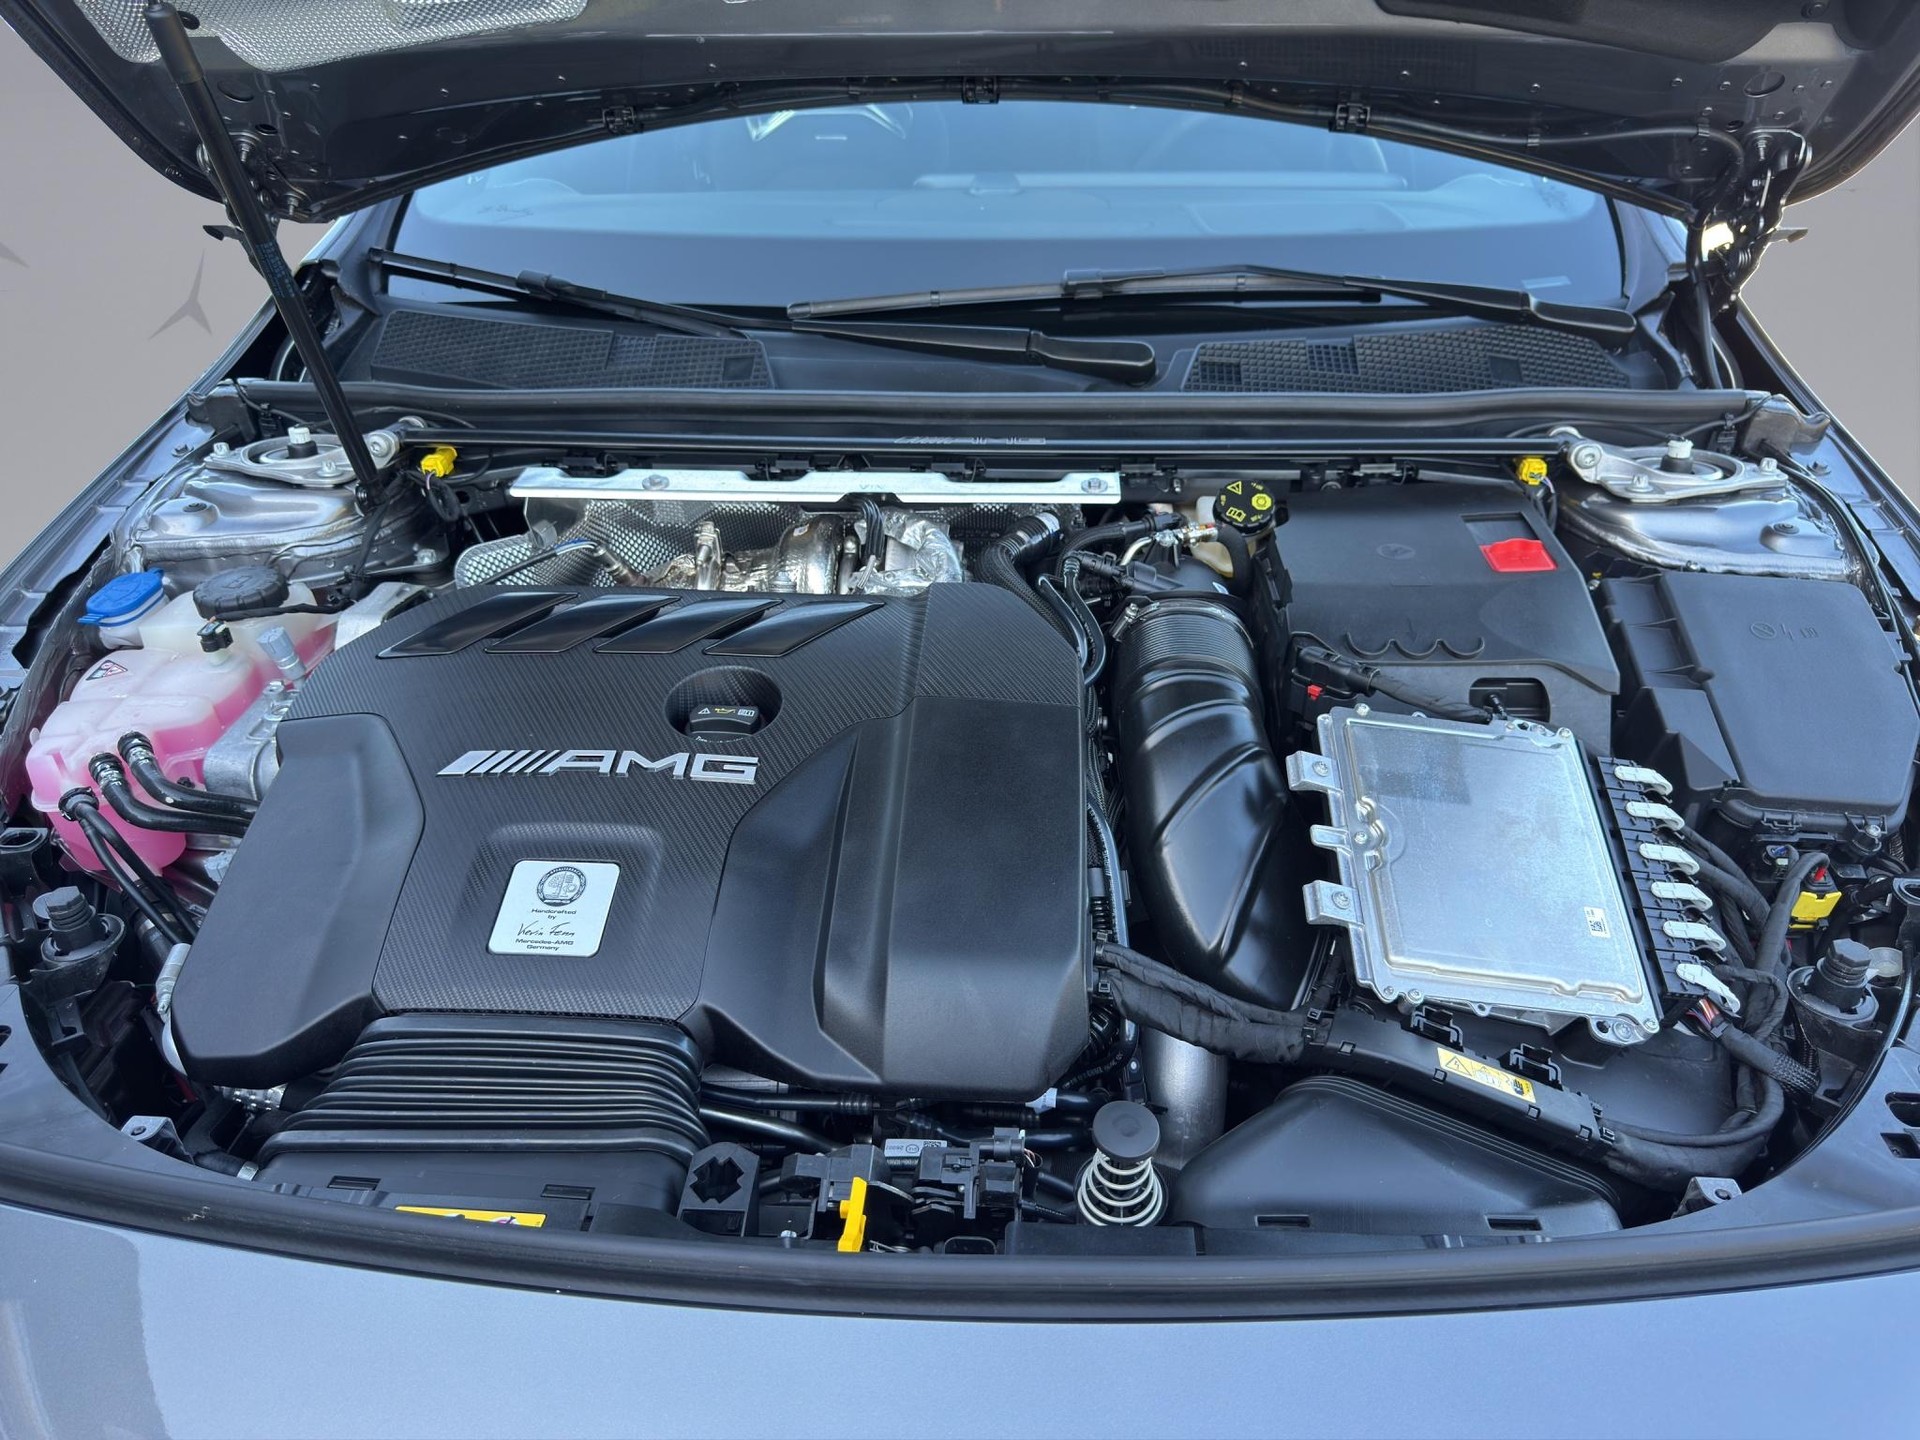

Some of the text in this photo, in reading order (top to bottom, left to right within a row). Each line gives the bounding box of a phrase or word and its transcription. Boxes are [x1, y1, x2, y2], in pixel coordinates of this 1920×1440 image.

[537, 750, 759, 785] AMG
[517, 920, 543, 936] Kevin
[515, 938, 574, 946] Mercedes-AMG
